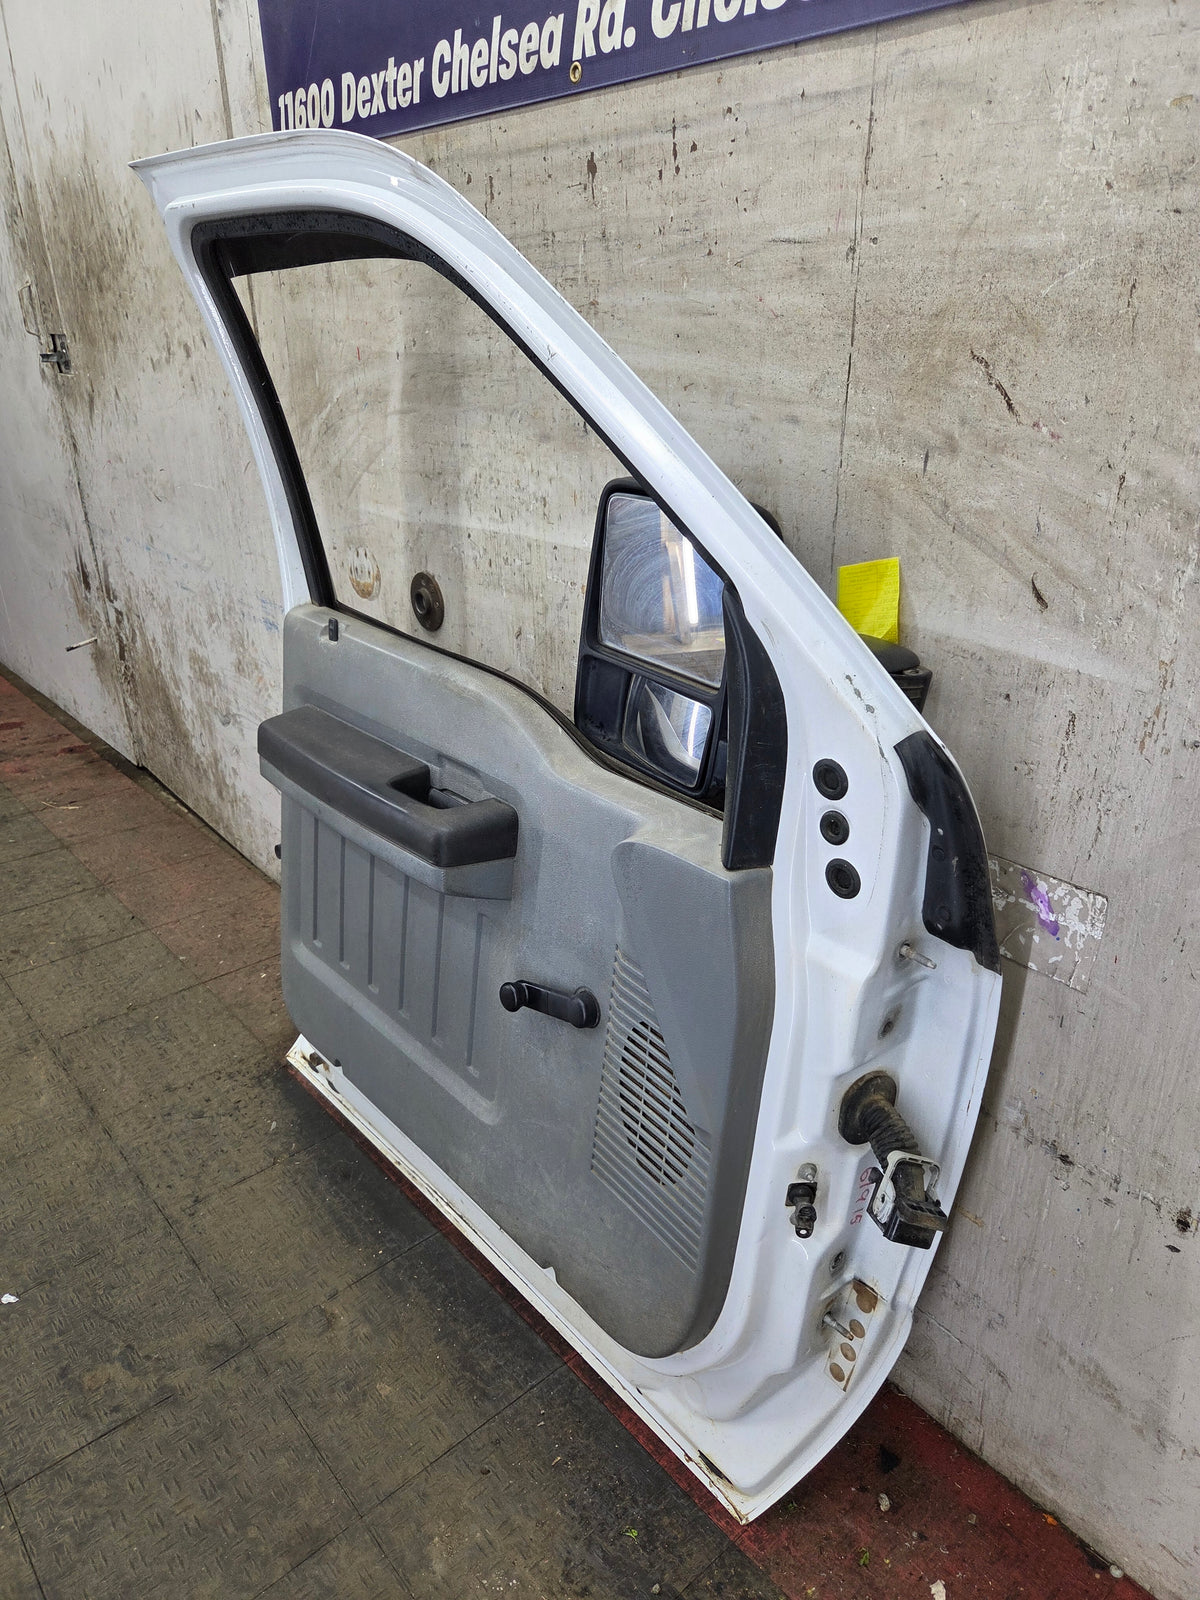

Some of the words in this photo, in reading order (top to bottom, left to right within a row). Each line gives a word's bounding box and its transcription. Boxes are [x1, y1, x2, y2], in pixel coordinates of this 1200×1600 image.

[278, 78, 335, 131] 11600
[341, 56, 425, 123] Dexter
[431, 14, 565, 98] Chelsea
[572, 0, 636, 61] Rd.
